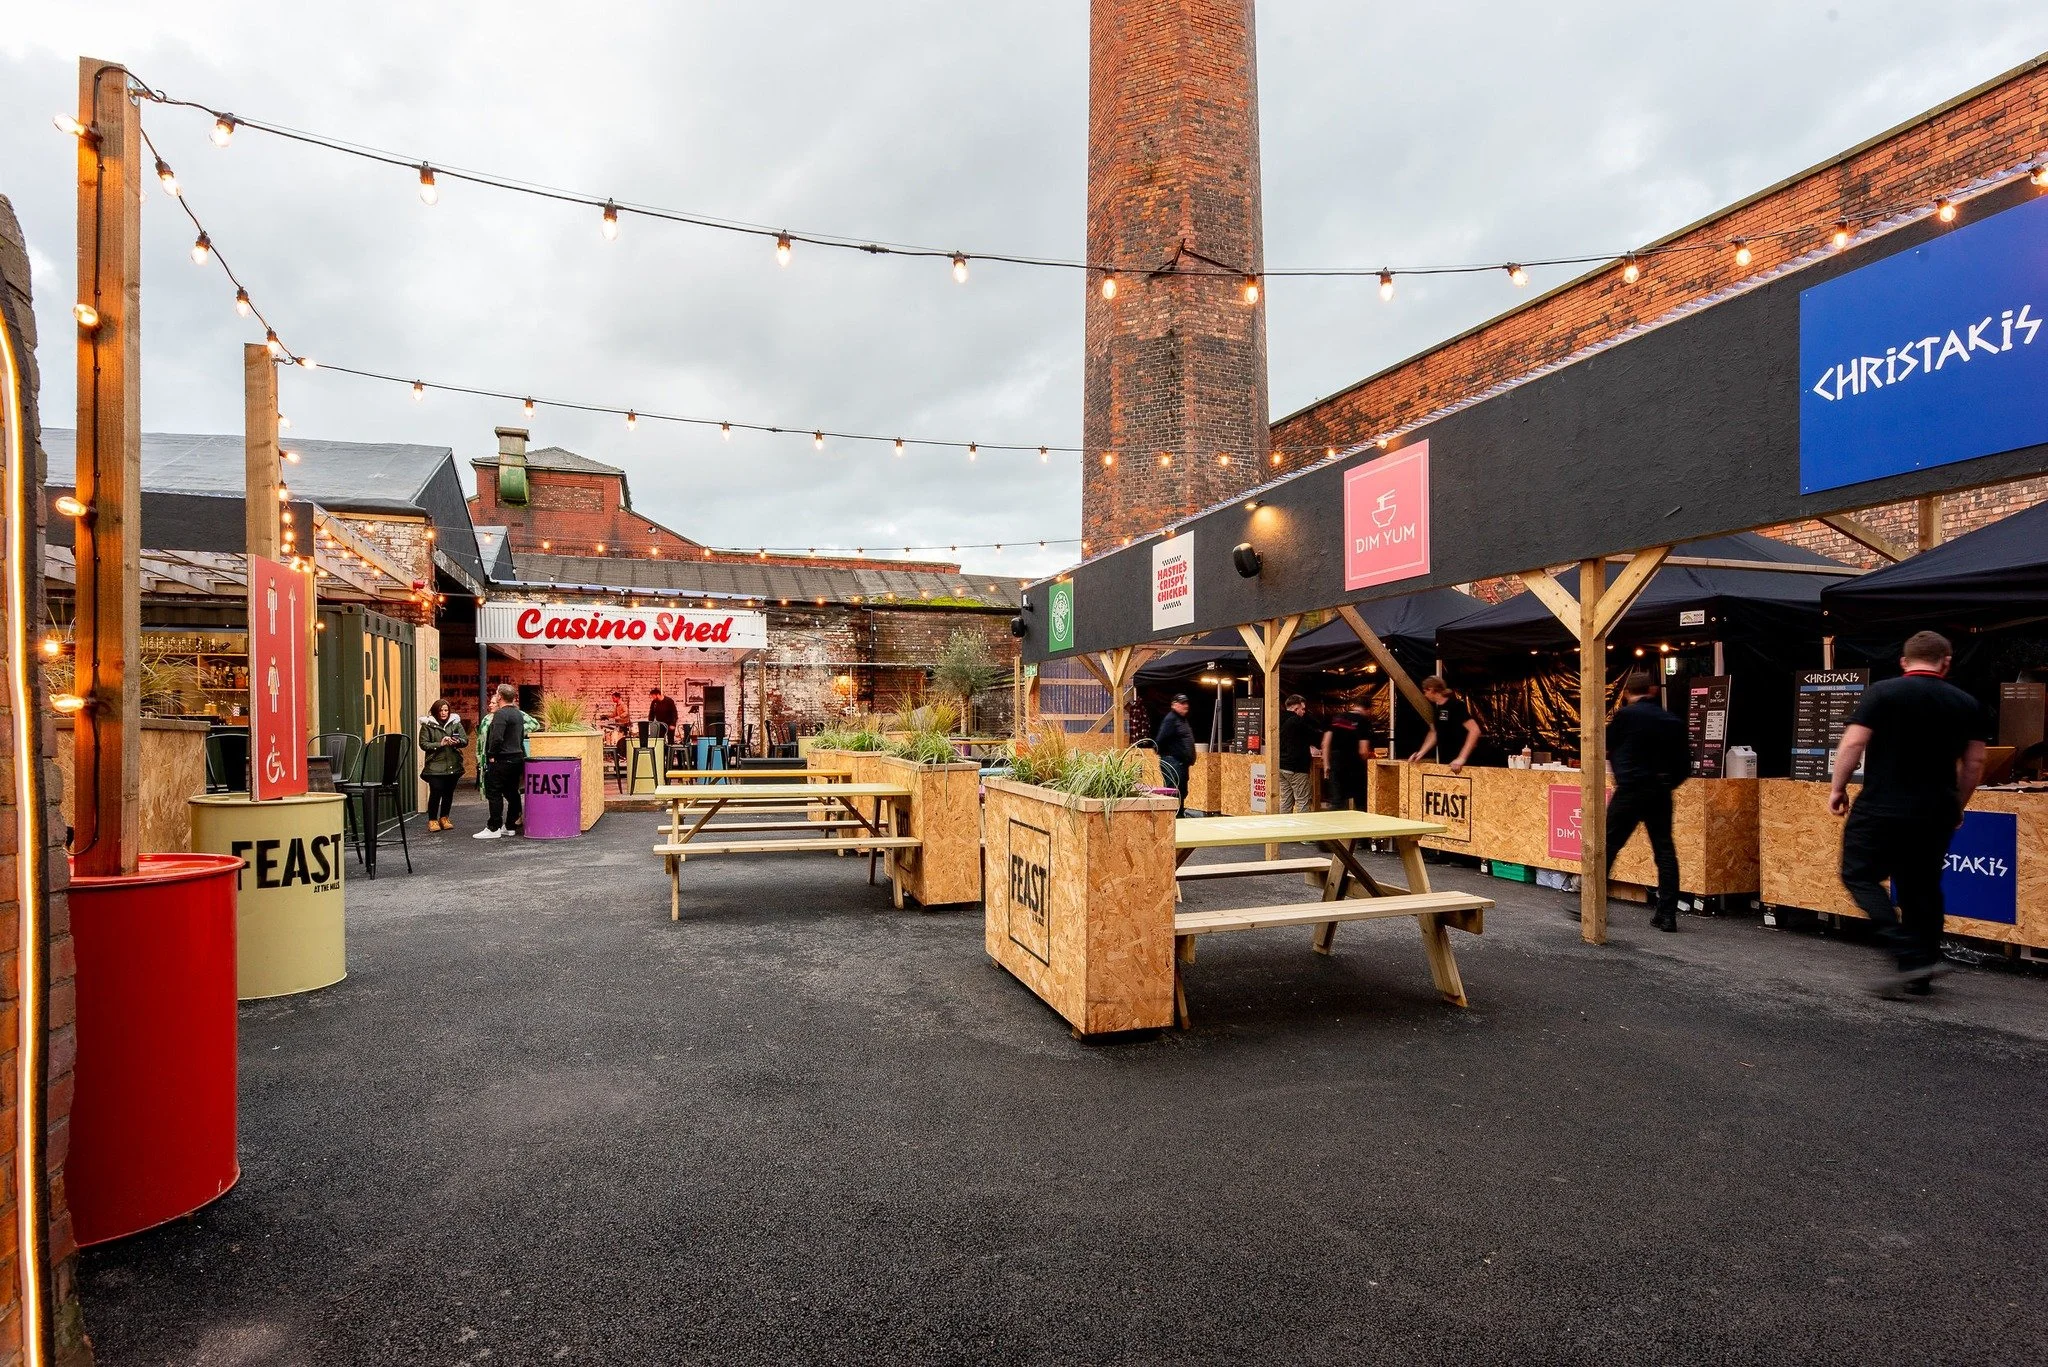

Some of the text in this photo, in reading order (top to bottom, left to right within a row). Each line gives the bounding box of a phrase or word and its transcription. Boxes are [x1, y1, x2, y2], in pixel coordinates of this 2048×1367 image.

[1355, 523, 1416, 554] DIM YUM
[1157, 585, 1188, 603] CHICKEN
[1159, 574, 1185, 591] CRISPY
[516, 608, 734, 643] Casino Shed
[527, 773, 571, 795] FEAST
[1425, 791, 1468, 819] FEAST
[1556, 827, 1575, 840] DIM
[231, 833, 341, 891] FEAST
[1011, 854, 1047, 917] FEAST
